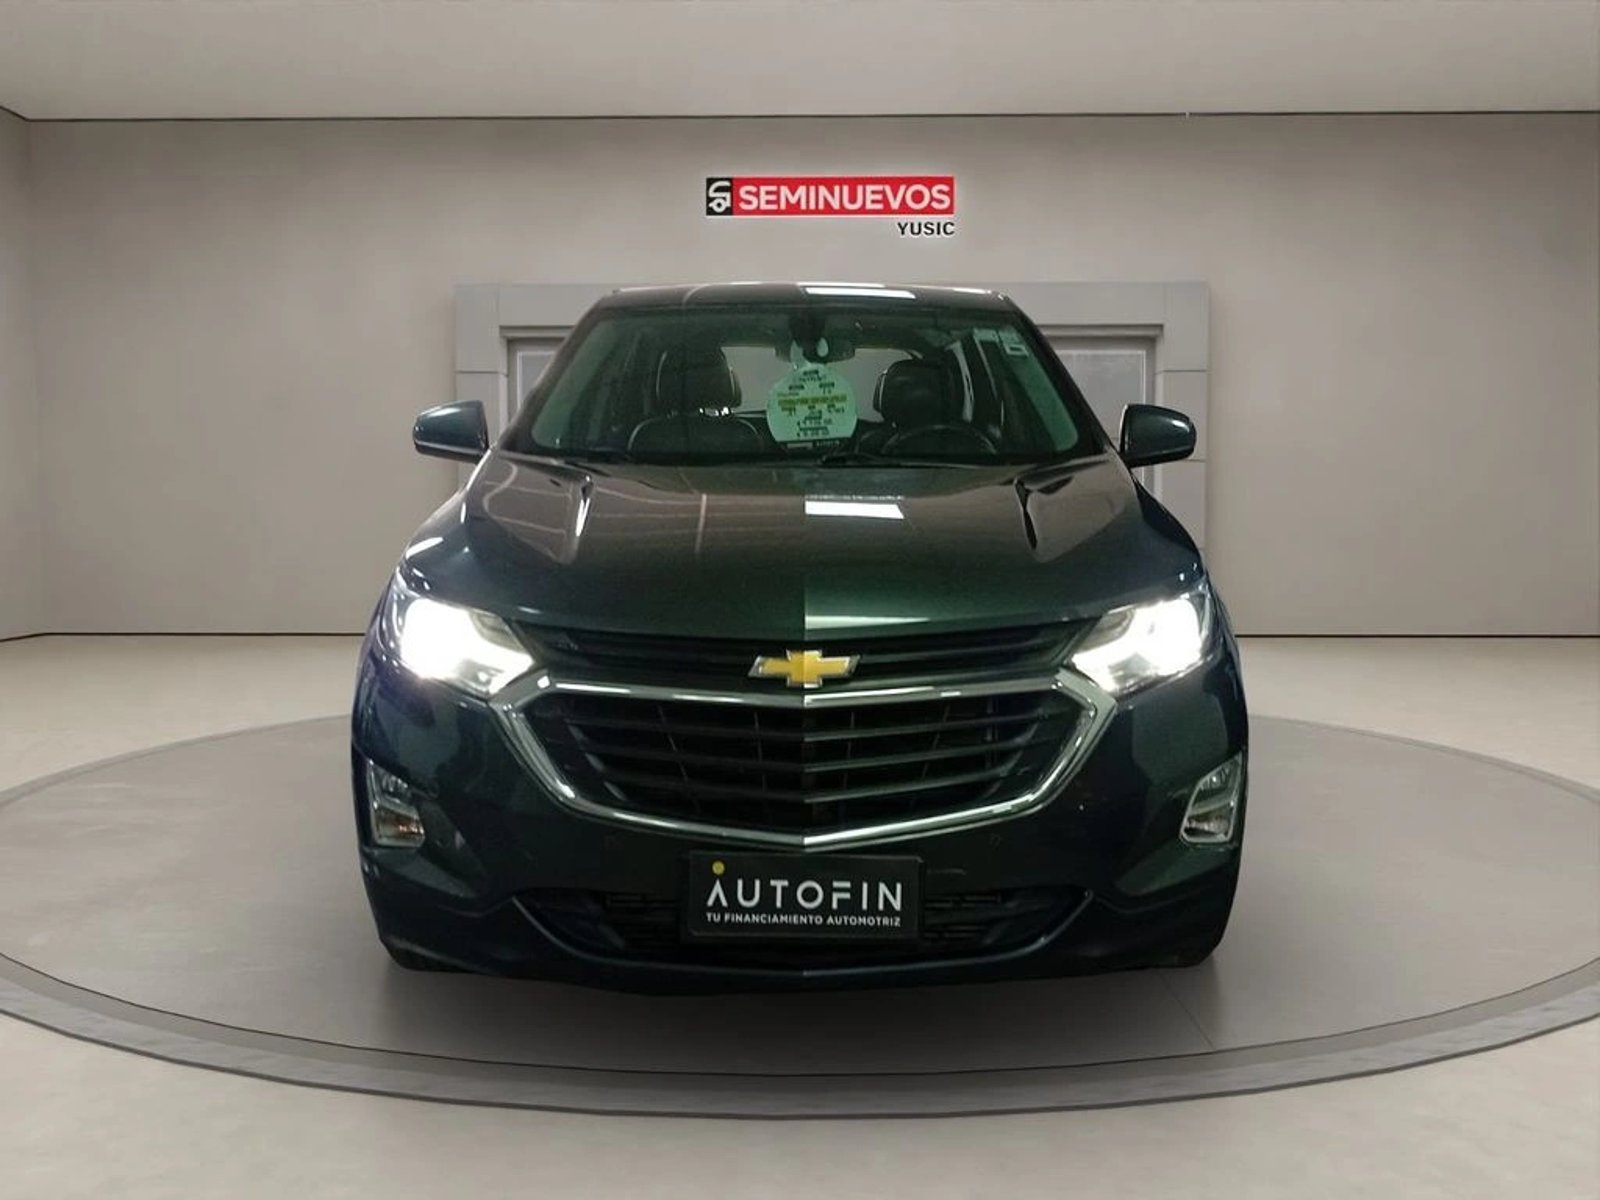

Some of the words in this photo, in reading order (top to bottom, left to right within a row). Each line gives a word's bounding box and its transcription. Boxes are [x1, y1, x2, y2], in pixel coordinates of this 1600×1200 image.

[738, 183, 951, 211] SEMINUEVOS
[897, 221, 956, 236] YUSIC
[706, 877, 903, 911] AUTOFIN
[706, 912, 721, 922] TU
[724, 913, 823, 925] FINANCIAMIENTO
[826, 915, 901, 927] AUTOMOTRIZ
